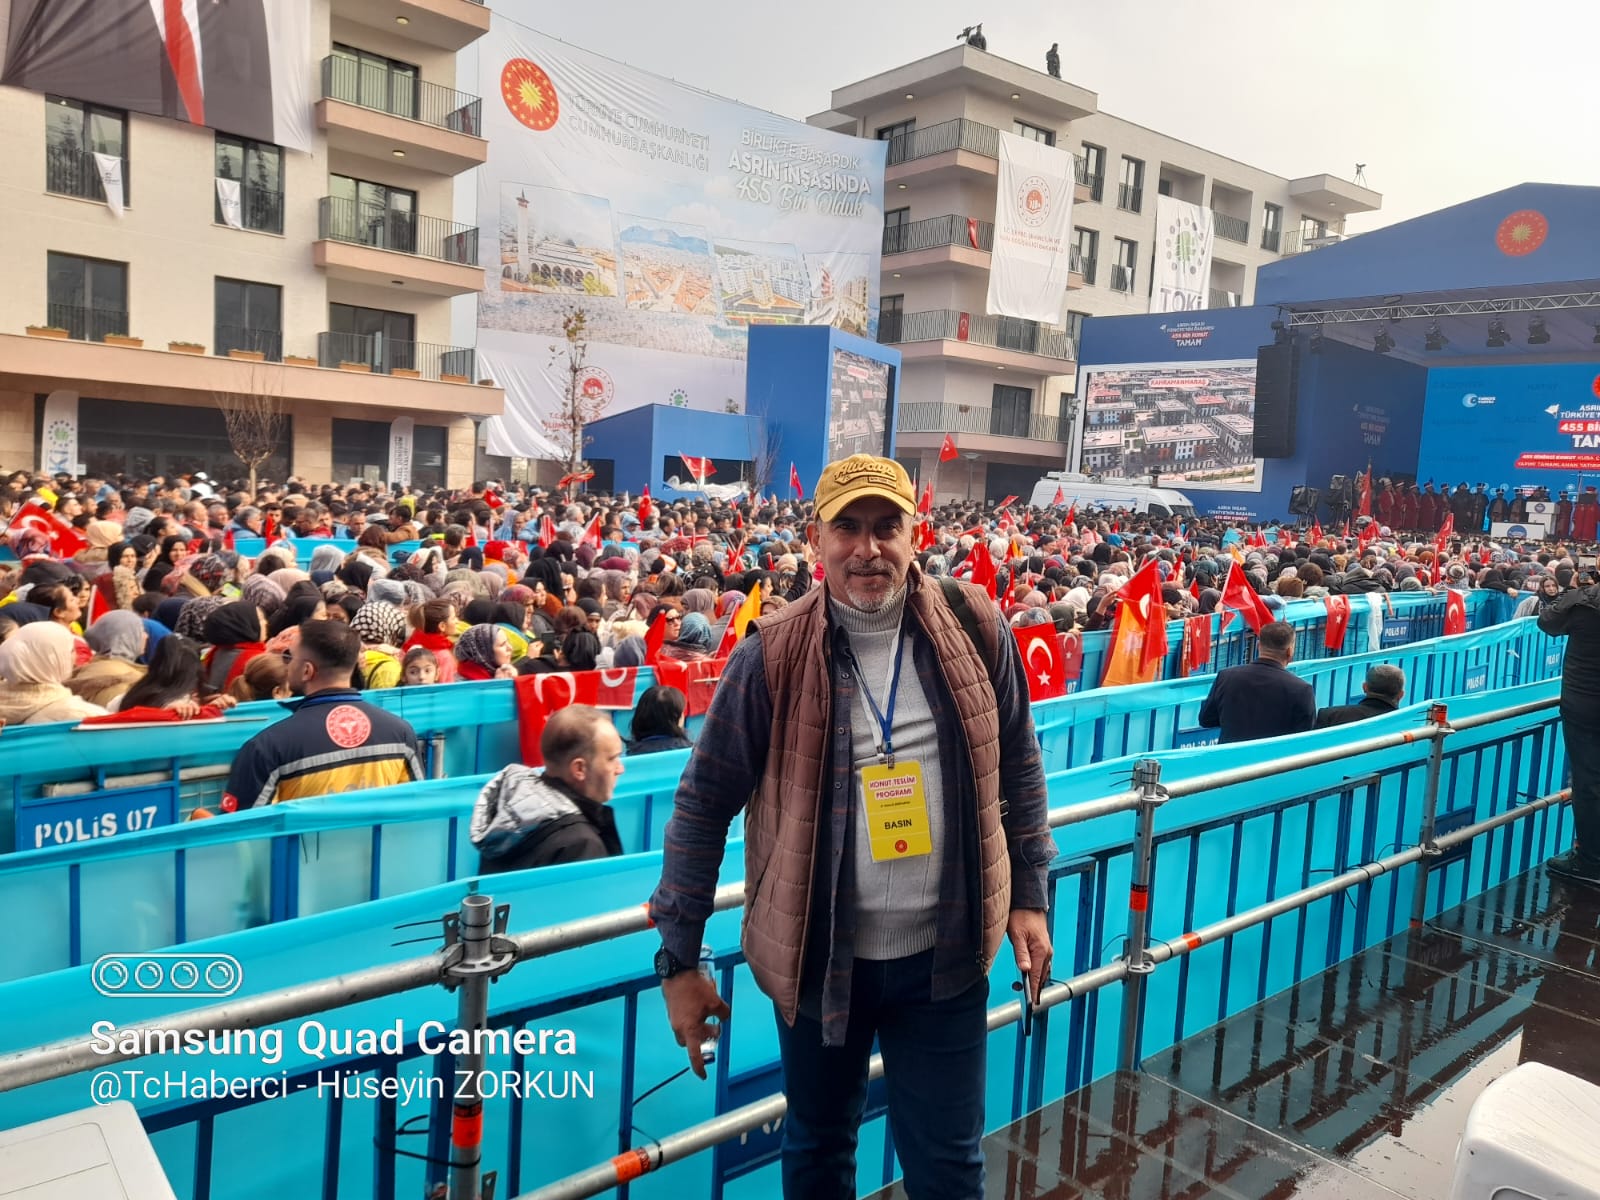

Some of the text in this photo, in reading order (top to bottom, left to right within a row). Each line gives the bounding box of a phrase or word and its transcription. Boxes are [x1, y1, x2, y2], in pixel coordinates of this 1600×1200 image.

[741, 127, 860, 170] BİRLİKTE BAŞARDIK
[727, 149, 872, 196] ASRIN İNŞASINDA
[735, 176, 864, 217] 455 Bin Olduk
[1176, 339, 1202, 347] TAMAM
[1560, 422, 1584, 432] 455
[875, 788, 913, 799] PROGRAMI
[126, 805, 158, 832] 07
[884, 818, 913, 831] BASIN
